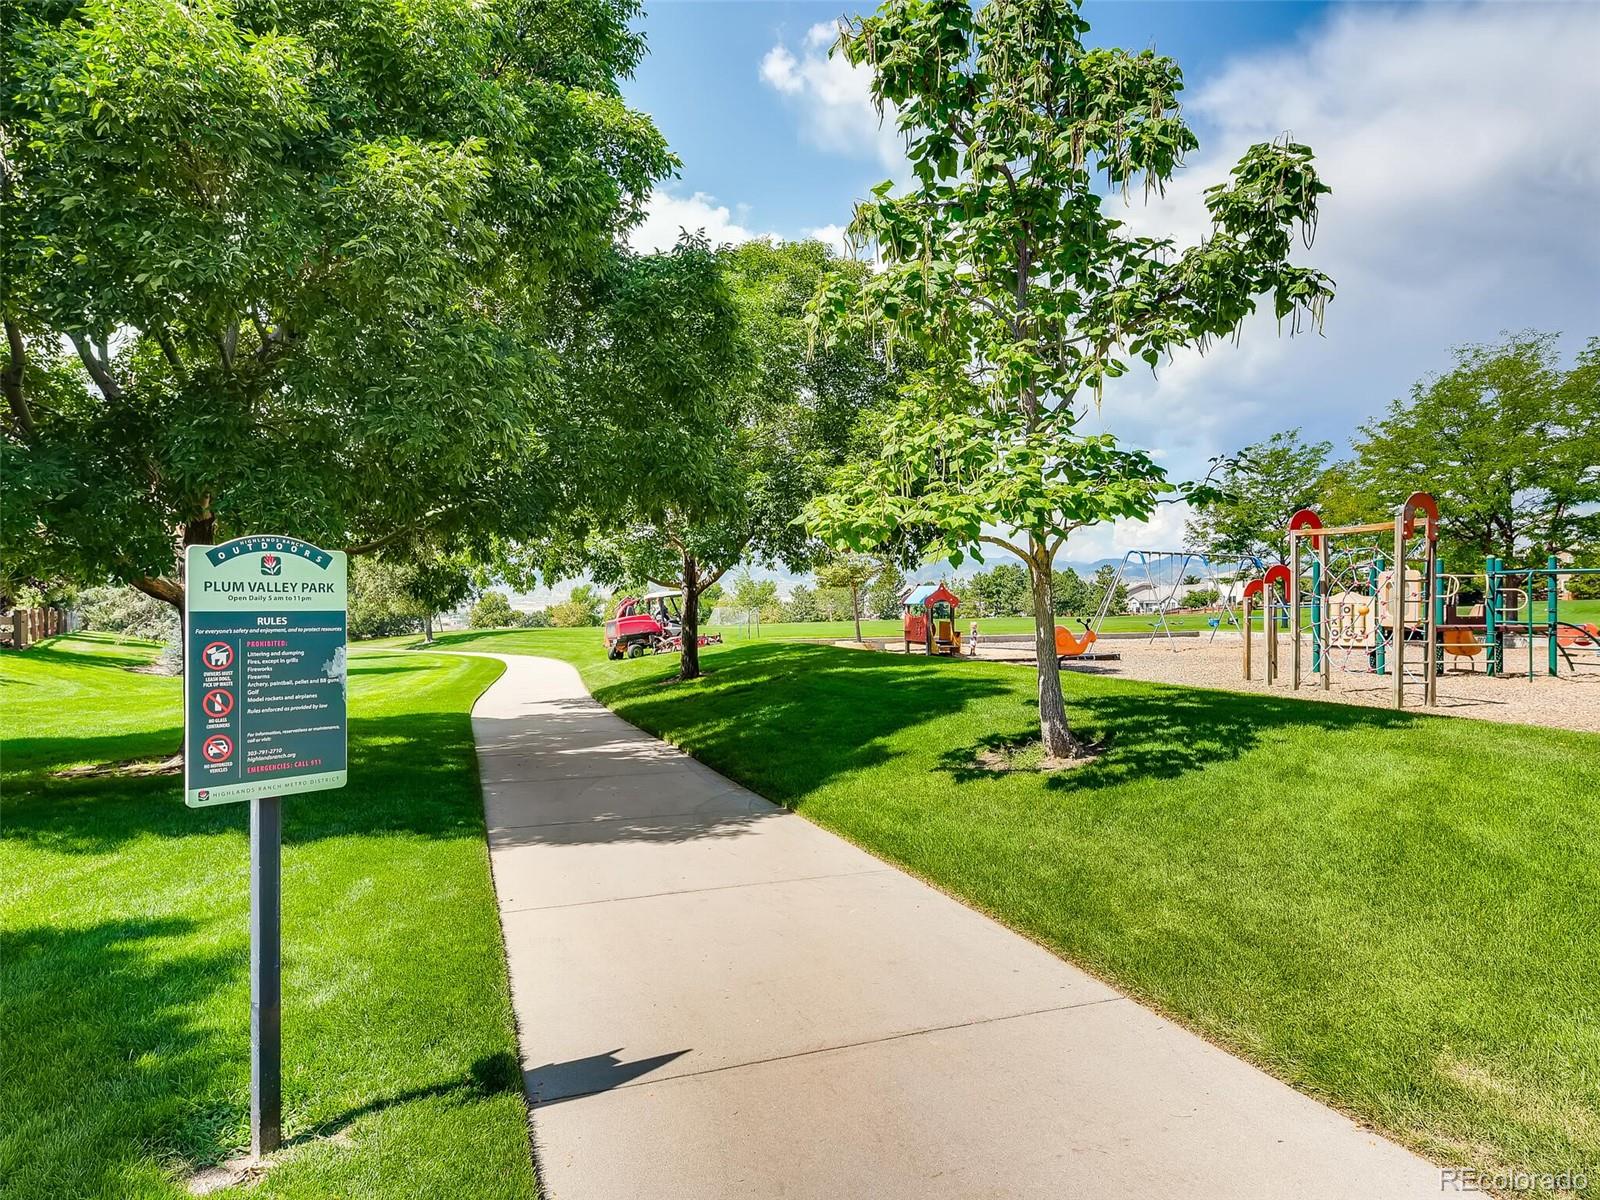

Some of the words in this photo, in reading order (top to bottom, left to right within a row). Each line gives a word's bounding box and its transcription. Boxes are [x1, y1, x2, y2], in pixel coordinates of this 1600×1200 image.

[282, 540, 304, 548] RANCH
[218, 542, 322, 562] OUTDOORS
[204, 581, 244, 592] PLUM
[248, 582, 298, 592] VALLEY
[302, 582, 334, 593] PARK
[258, 617, 288, 626] RULES
[248, 748, 282, 756] 303-791-2710
[247, 762, 293, 774] EMERGENCIES:
[213, 787, 255, 797] HIGHLANDS
[258, 783, 282, 791] RANCH
[310, 776, 340, 784] DISTRICT
